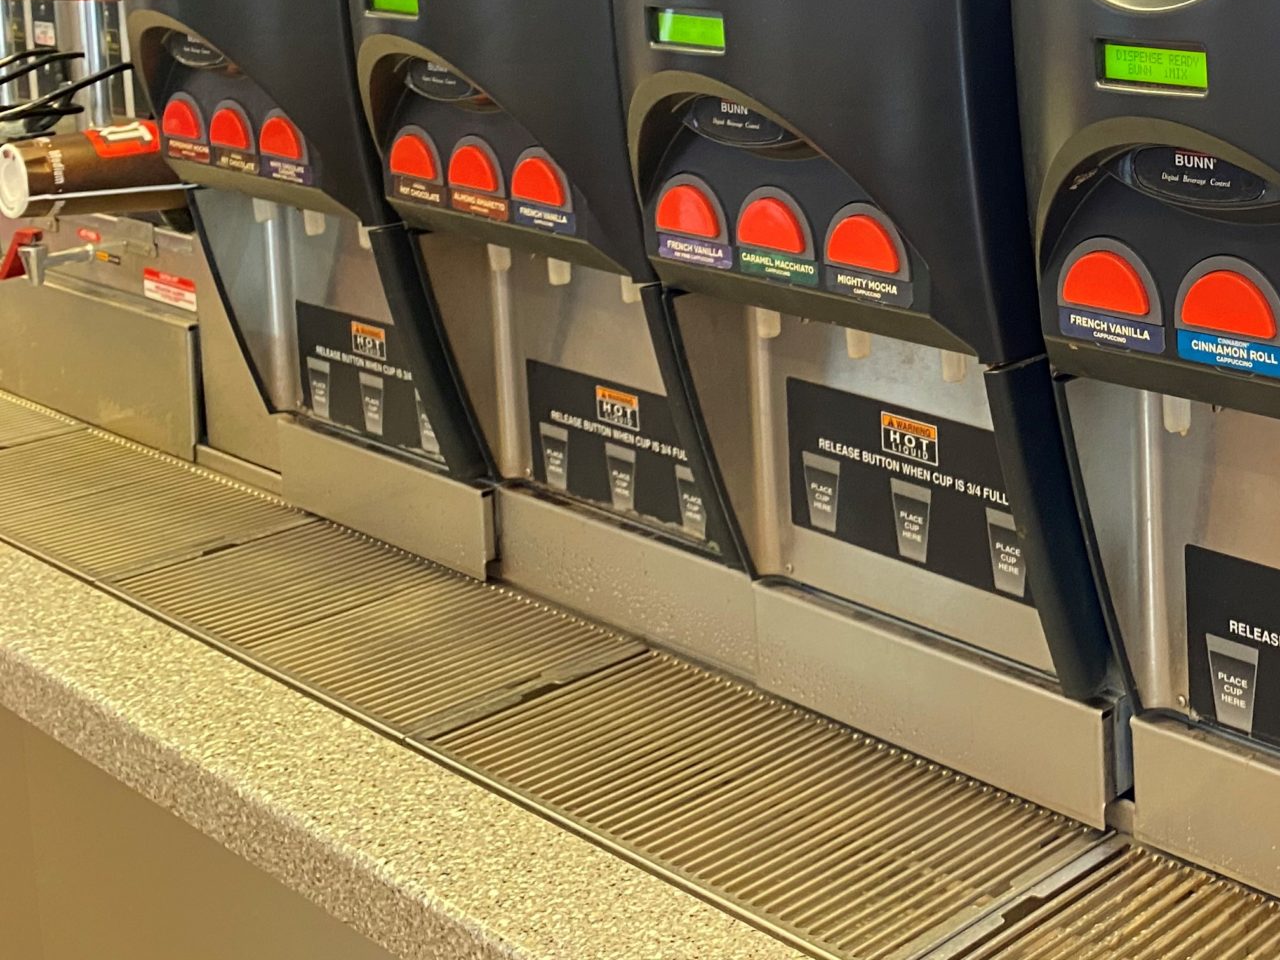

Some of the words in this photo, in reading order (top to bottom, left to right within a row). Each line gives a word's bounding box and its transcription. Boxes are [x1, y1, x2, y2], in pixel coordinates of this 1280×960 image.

[1116, 49, 1164, 65] DISPENSE
[1168, 54, 1200, 68] READY
[1128, 63, 1152, 76] BUNN
[721, 102, 748, 115] BUNN
[667, 240, 694, 252] FRENCH
[694, 245, 723, 258] VANILLA
[741, 252, 773, 267] CARAMEL
[774, 259, 815, 275] MACCHIATO
[837, 274, 867, 290] MIGHTY
[868, 279, 898, 295] MOCHA
[1070, 314, 1107, 331] FRENCH
[1109, 322, 1150, 340] VANILLA
[1093, 331, 1127, 344] CAPPUCCINO
[1191, 340, 1248, 359] CINNAMON
[1250, 350, 1278, 365] ROLL
[1216, 356, 1253, 368] CAPPUCCINO
[602, 402, 632, 419] HOT
[551, 410, 582, 429] RELEASE
[583, 420, 611, 437] BUTTON
[612, 429, 634, 445] WHEN
[635, 436, 651, 449] CUP
[896, 421, 931, 437] WARNING
[890, 430, 929, 452] HOT
[892, 443, 929, 460] LIQUID
[818, 438, 860, 460] RELEASE
[862, 451, 900, 473] BUTTON
[901, 462, 931, 481] WHEN
[932, 472, 953, 488] CUP
[955, 479, 965, 492] IS
[966, 483, 981, 497] 3/4
[983, 487, 1009, 505] FULL
[810, 482, 833, 495] PLACE
[815, 492, 830, 503] CUP
[900, 510, 924, 525] PLACE
[904, 522, 920, 532] CUP
[995, 541, 1021, 557] PLACE
[1000, 553, 1017, 564] CUP
[1217, 671, 1248, 689] PLACE
[1224, 684, 1243, 697] CUP
[1221, 693, 1246, 709] HERE
